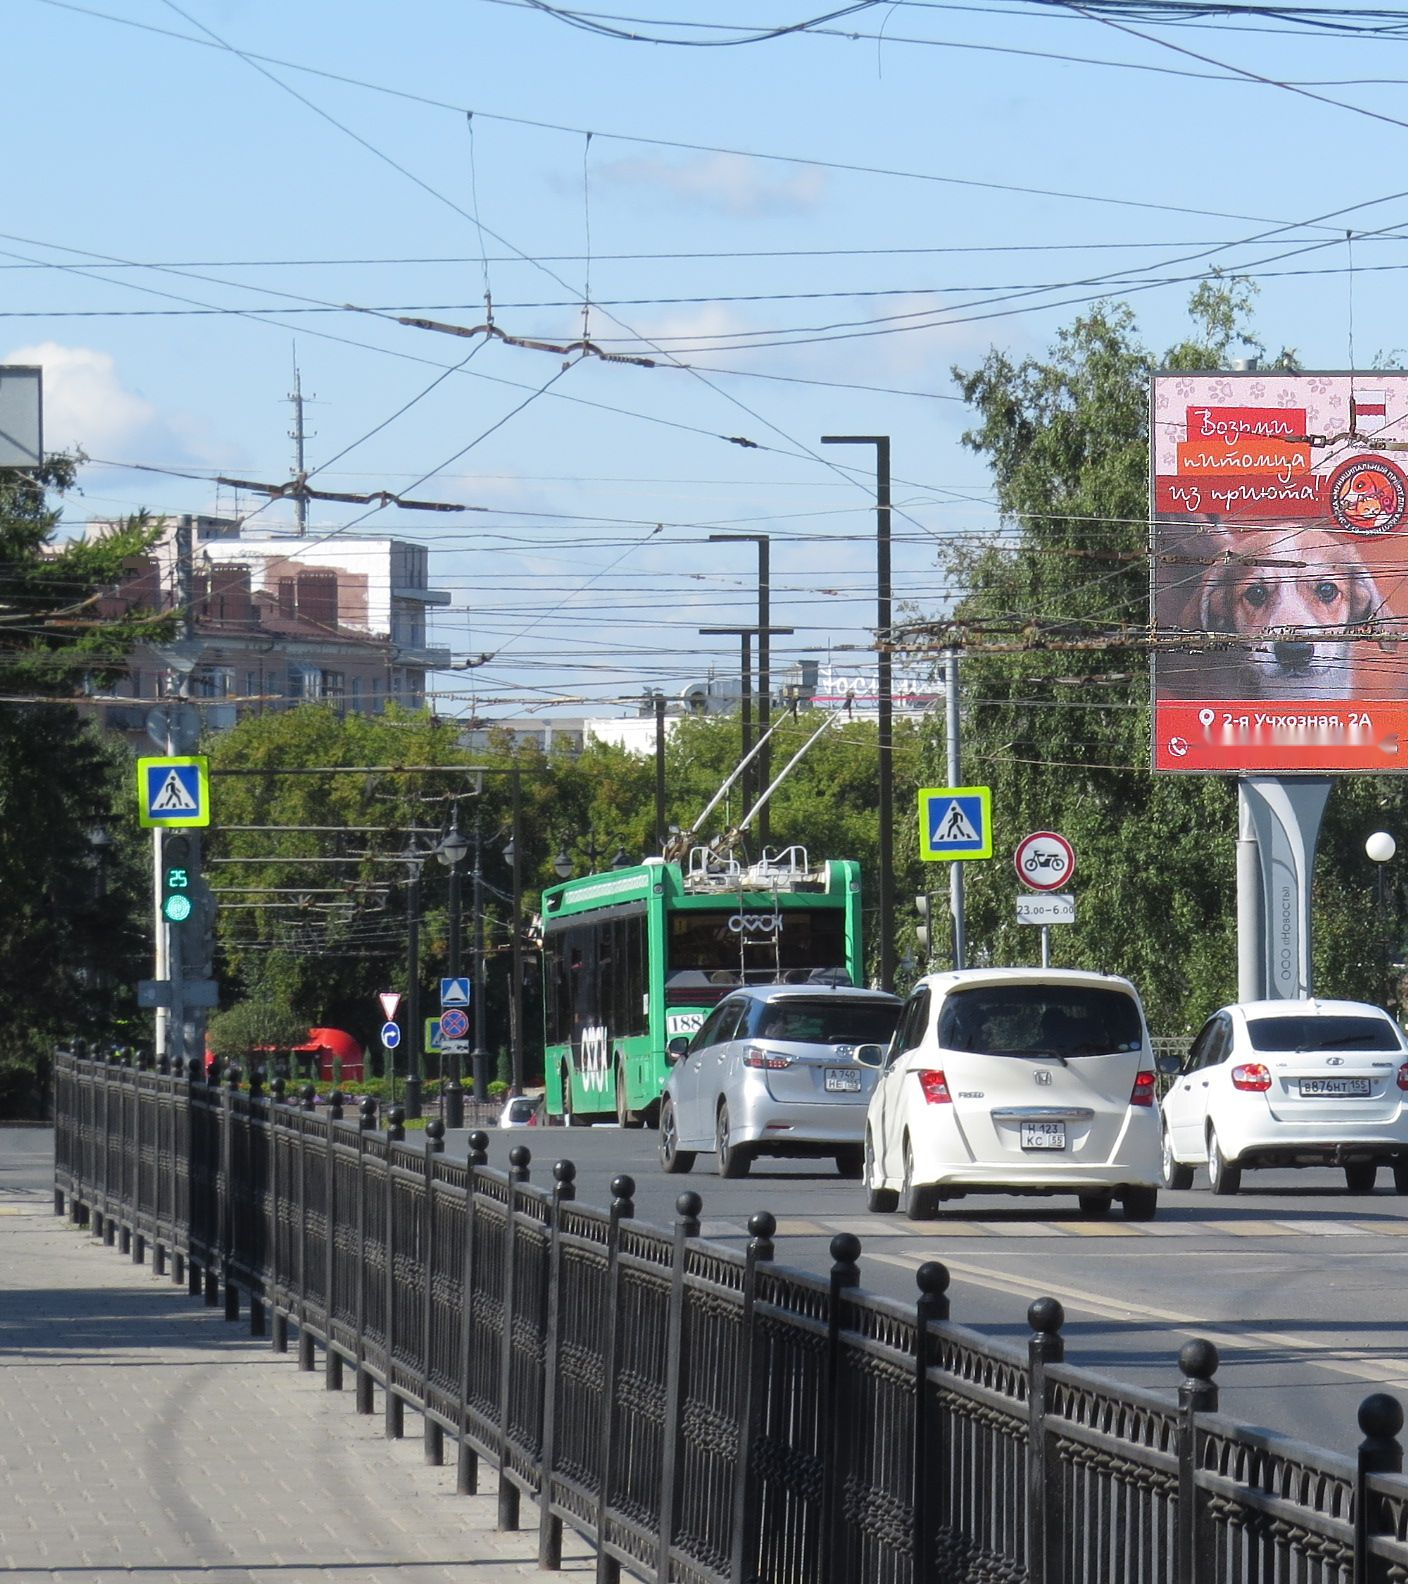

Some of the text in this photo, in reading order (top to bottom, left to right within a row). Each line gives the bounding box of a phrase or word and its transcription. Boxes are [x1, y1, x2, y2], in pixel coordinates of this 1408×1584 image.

[1194, 408, 1293, 446] Возьми
[1183, 451, 1306, 484] питомца
[1169, 473, 1321, 511] из приюта!
[1223, 713, 1249, 726] 2-я
[169, 870, 188, 887] 25
[1281, 948, 1291, 980] ООО
[671, 1015, 702, 1032] 188
[1305, 1080, 1366, 1092] В876НТ 155
[1040, 1124, 1058, 1134] 123
